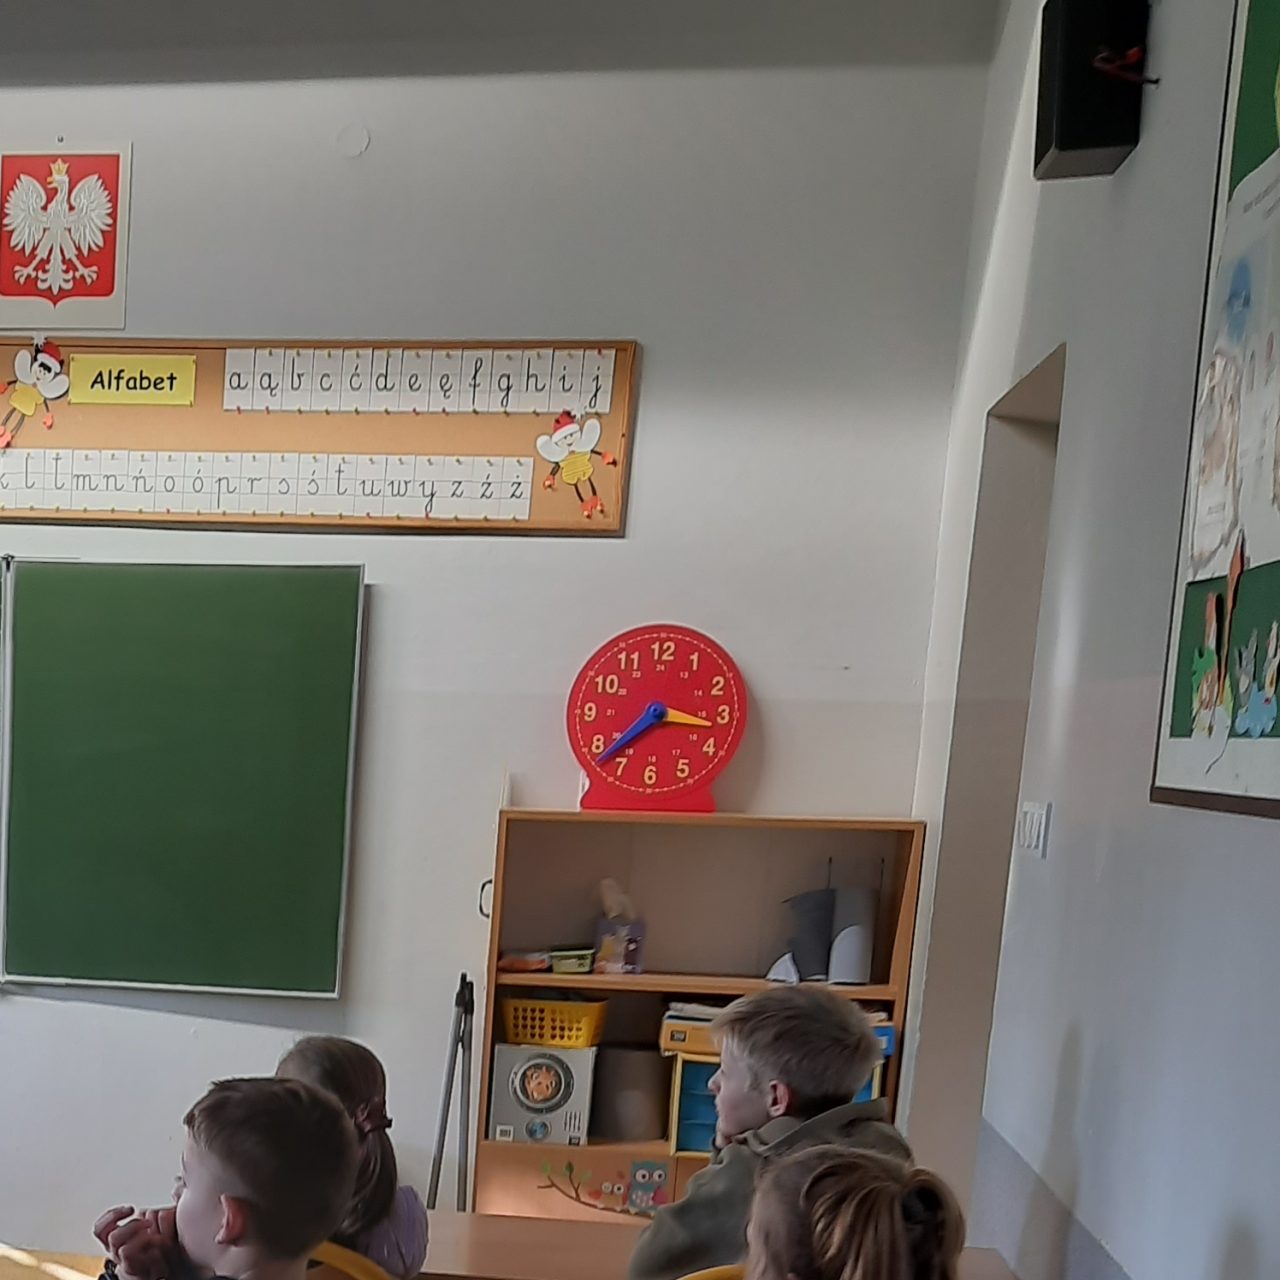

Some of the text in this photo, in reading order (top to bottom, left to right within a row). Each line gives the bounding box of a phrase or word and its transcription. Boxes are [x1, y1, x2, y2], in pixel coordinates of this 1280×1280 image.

[90, 368, 177, 392] Alfabet
[229, 370, 249, 390] a
[259, 370, 279, 397] ą
[319, 372, 333, 392] c
[349, 364, 363, 392] ć
[375, 357, 395, 392] d
[408, 373, 422, 392] e
[439, 373, 453, 399] ę
[469, 356, 483, 405] f
[497, 374, 513, 407] g
[525, 358, 546, 393] h
[559, 366, 573, 393] i
[589, 365, 602, 408] j
[25, 456, 36, 489] l
[72, 473, 99, 491] m
[103, 473, 125, 492] n
[132, 468, 153, 492] ń
[164, 475, 176, 492] o
[192, 468, 204, 493] ó
[216, 476, 237, 509] p
[247, 477, 262, 494] r
[307, 469, 320, 496] ś
[335, 462, 348, 495] t
[359, 479, 382, 497] u
[387, 479, 412, 498] w
[419, 480, 436, 512] y
[451, 480, 464, 499] z
[480, 474, 494, 499] ź
[510, 475, 524, 499] ż
[617, 651, 639, 670] 11
[650, 641, 675, 661] 12
[690, 652, 699, 671] 1
[595, 674, 619, 694] 10
[711, 676, 725, 695] 2
[584, 702, 596, 721] 9
[717, 705, 730, 724] 3
[591, 734, 604, 754] 8
[702, 737, 715, 757] 4
[615, 757, 627, 776] 7
[644, 765, 657, 785] 6
[676, 759, 690, 778] 5
